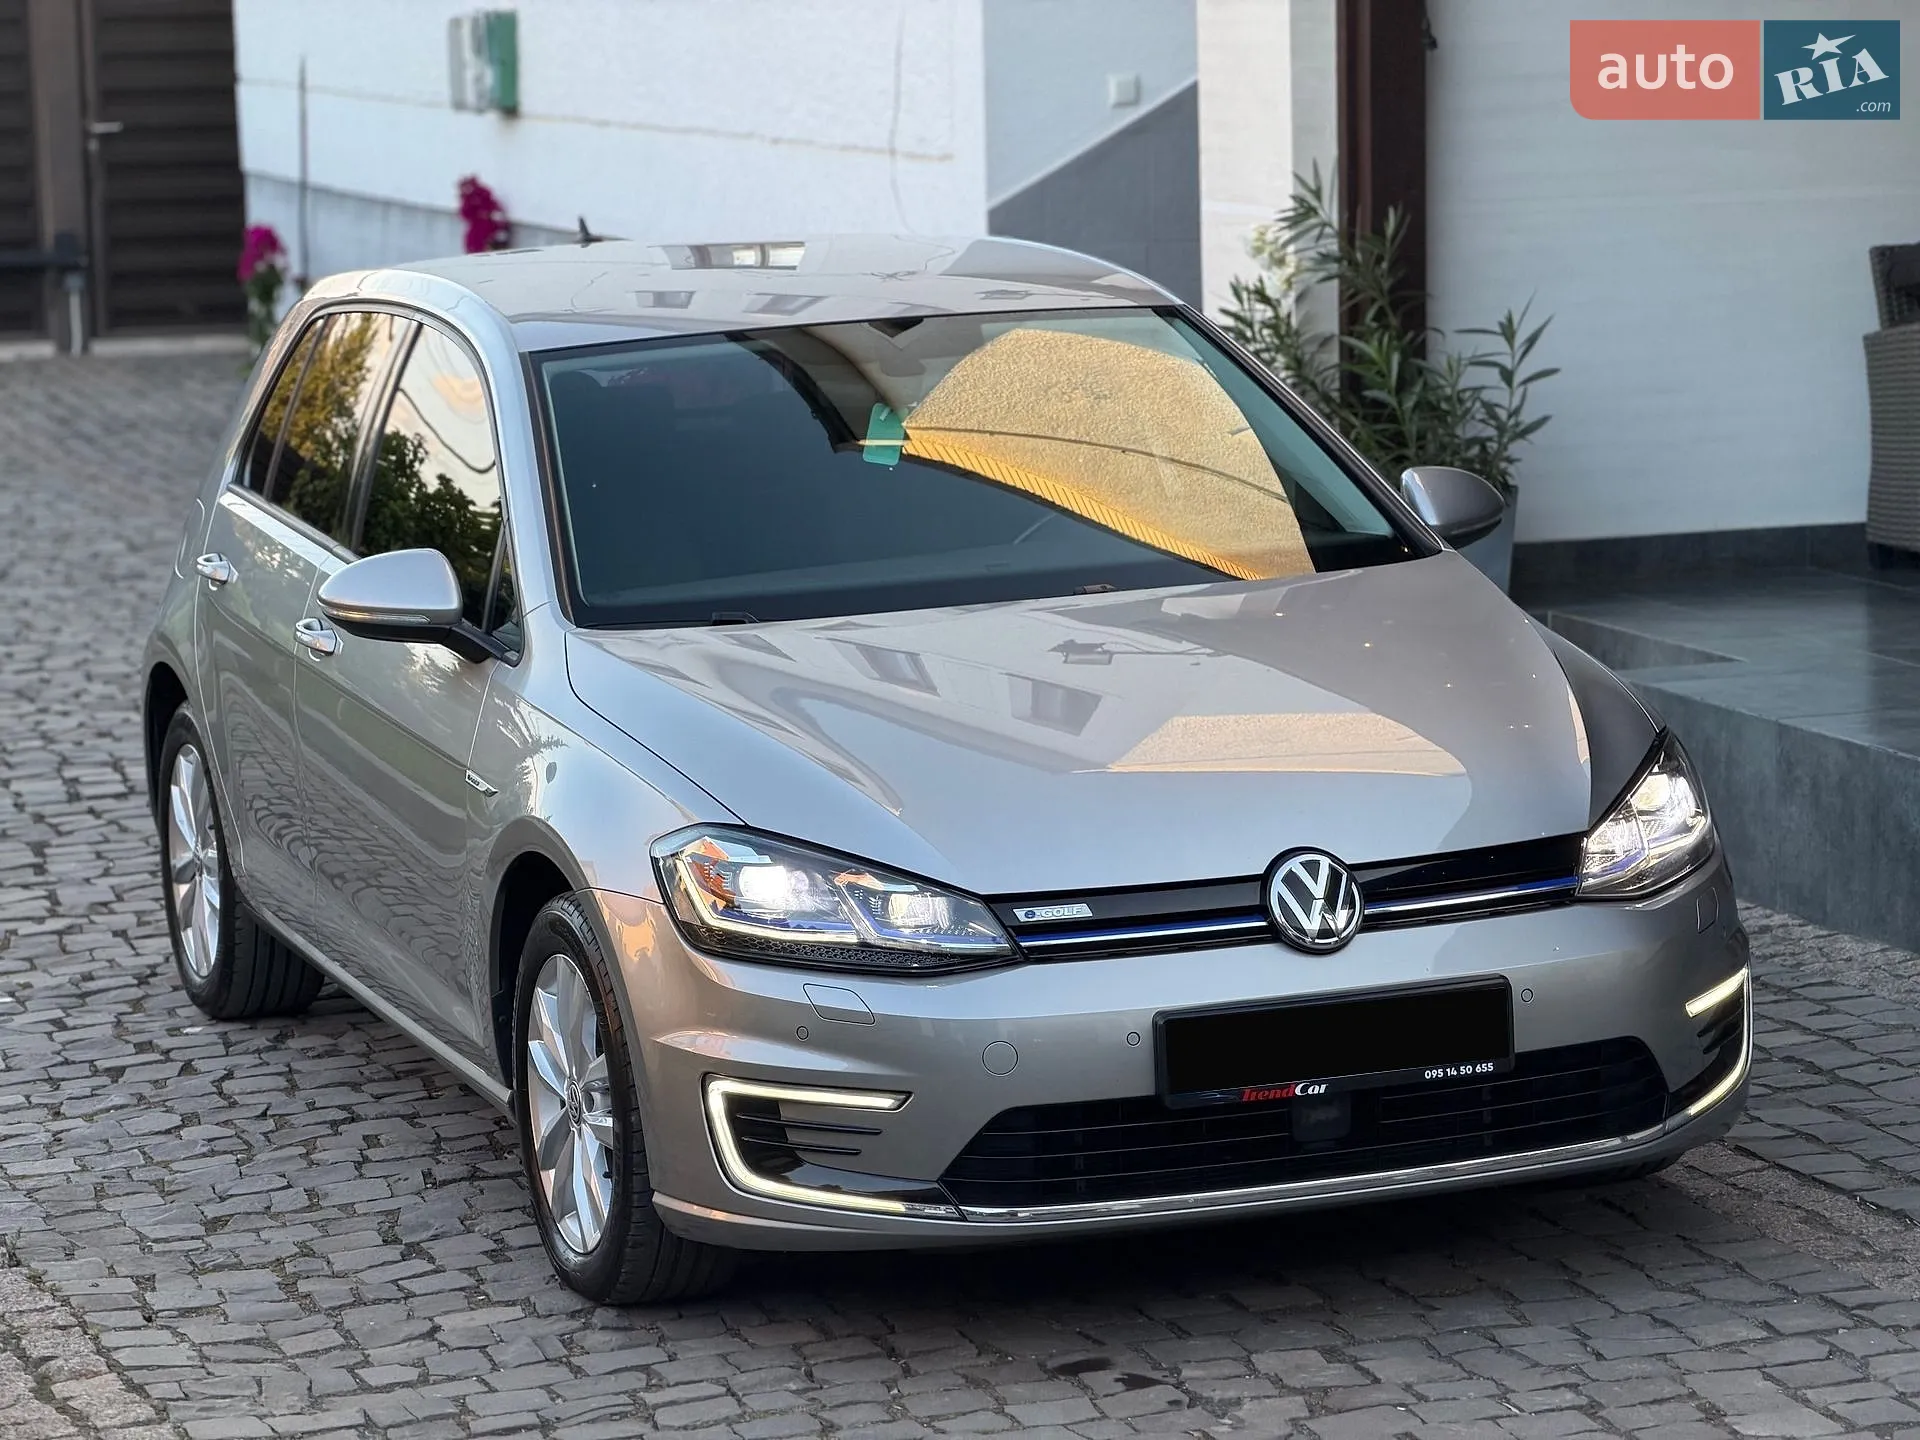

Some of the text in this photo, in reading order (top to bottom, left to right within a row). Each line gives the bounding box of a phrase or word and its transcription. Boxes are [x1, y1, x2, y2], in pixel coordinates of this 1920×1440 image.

[1424, 1062, 1494, 1079] 095 14 50 655
